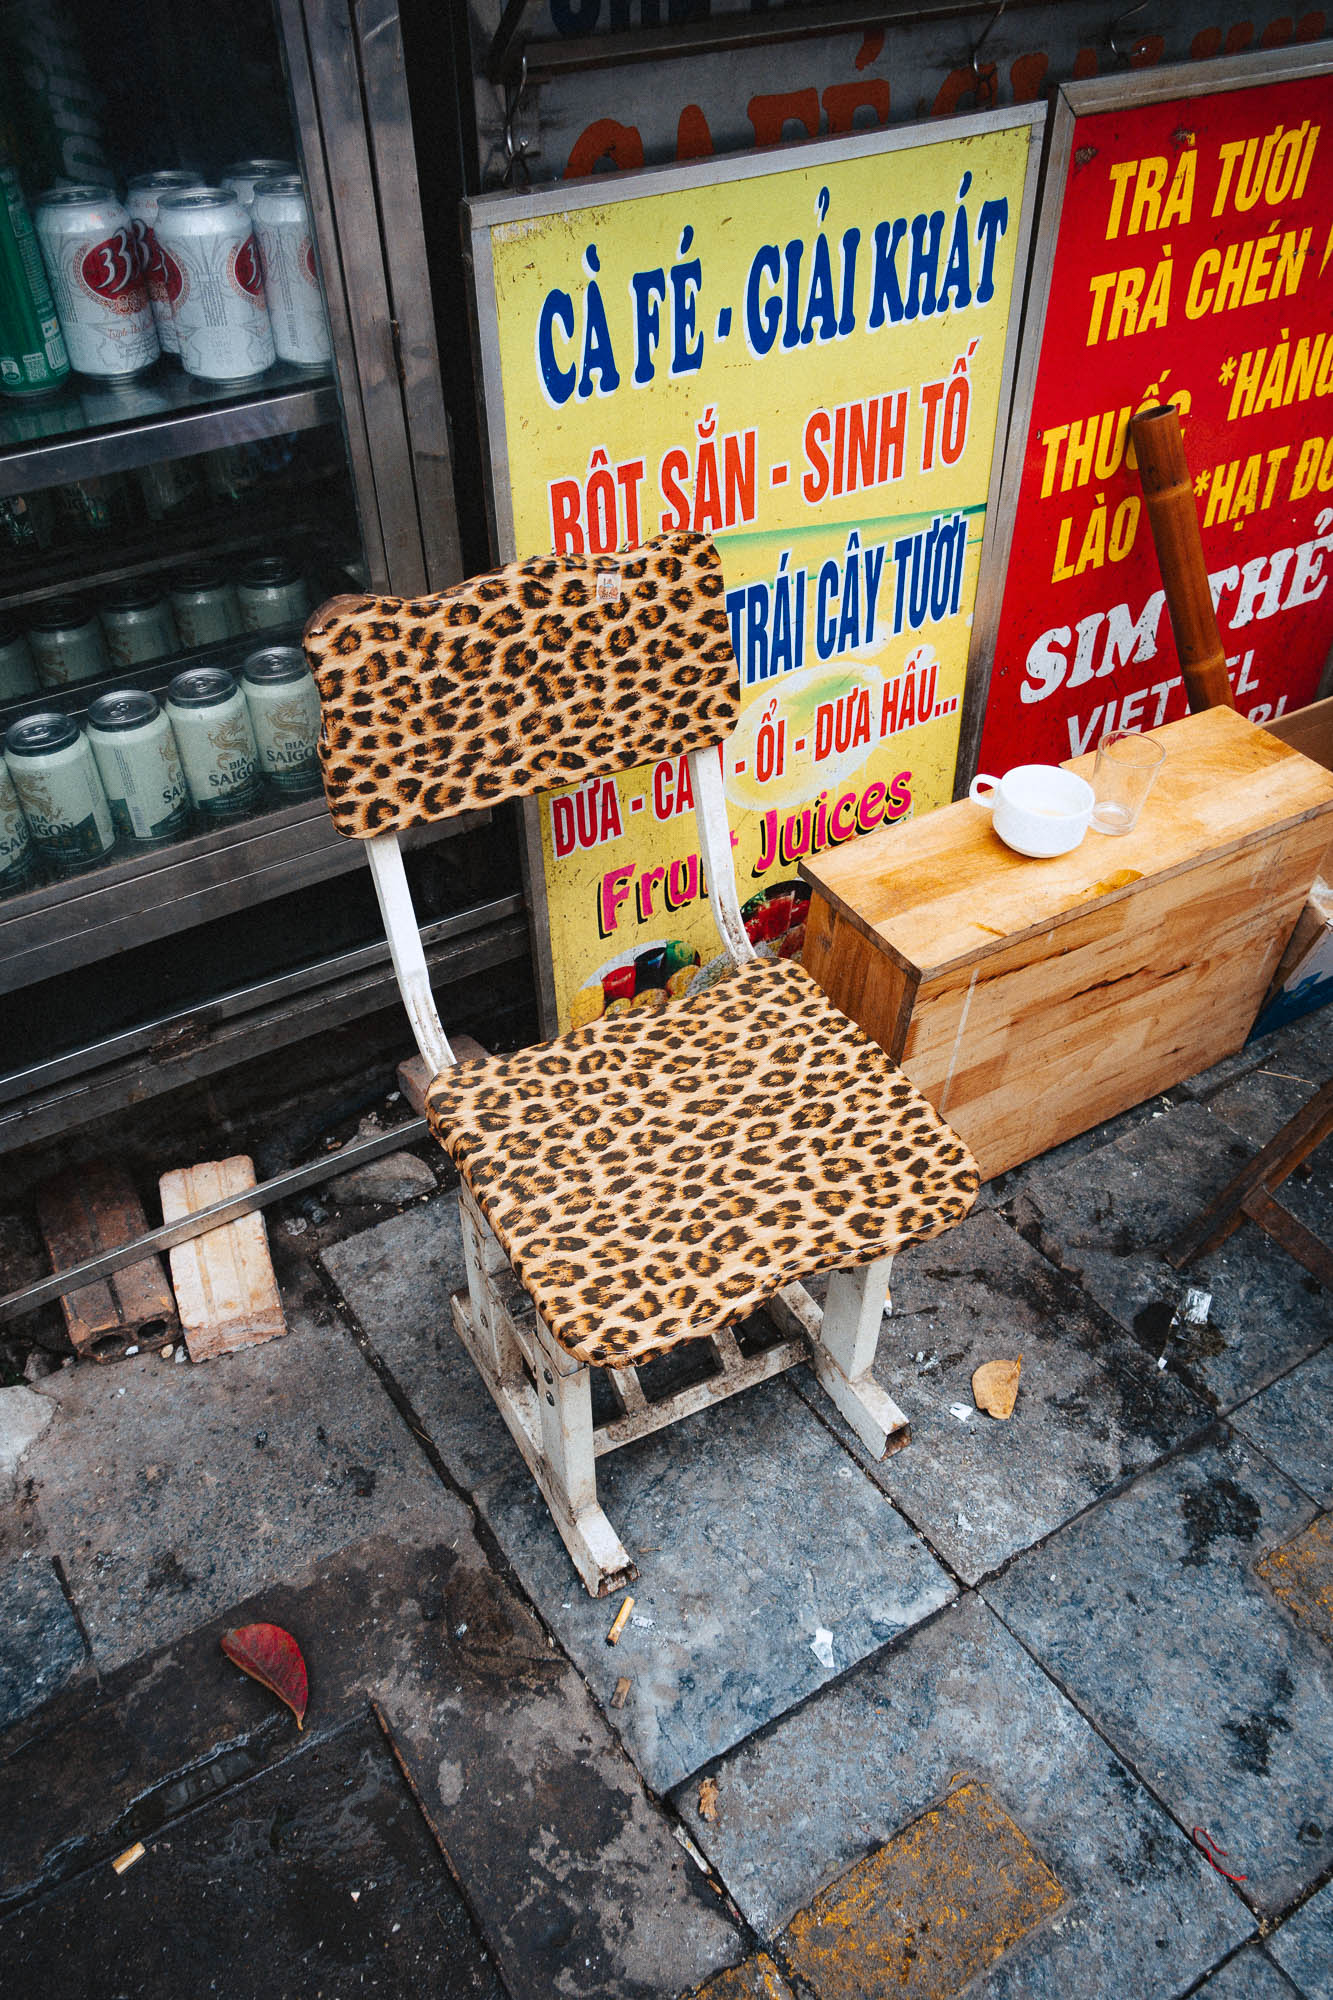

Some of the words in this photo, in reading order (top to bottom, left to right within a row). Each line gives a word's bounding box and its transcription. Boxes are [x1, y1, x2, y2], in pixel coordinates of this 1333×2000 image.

[1105, 133, 1198, 241] TRÀ
[1211, 119, 1321, 217] TƯƠI
[538, 243, 620, 405] CÀ
[630, 225, 704, 382] FÉ
[747, 186, 861, 356] GIẢI
[868, 171, 1009, 328] KHÁT
[1086, 244, 1174, 347] TRÀ
[1185, 220, 1312, 320] CHÉN
[661, 408, 756, 533] SẮN
[804, 391, 908, 504] SINH
[921, 341, 977, 471] TỐ
[726, 552, 805, 684] TRÁI
[816, 531, 885, 660] CÂY
[893, 514, 967, 634] TƯƠI
[1051, 493, 1141, 584] LÀO
[1020, 590, 1166, 704] SIM
[1067, 650, 1259, 757] VIETL
[209, 758, 258, 788] SAIGO
[654, 745, 724, 820] CA
[756, 698, 785, 783] ỔI
[815, 687, 870, 762] DƯA
[598, 830, 738, 939] Fru
[752, 771, 912, 878] Juices
